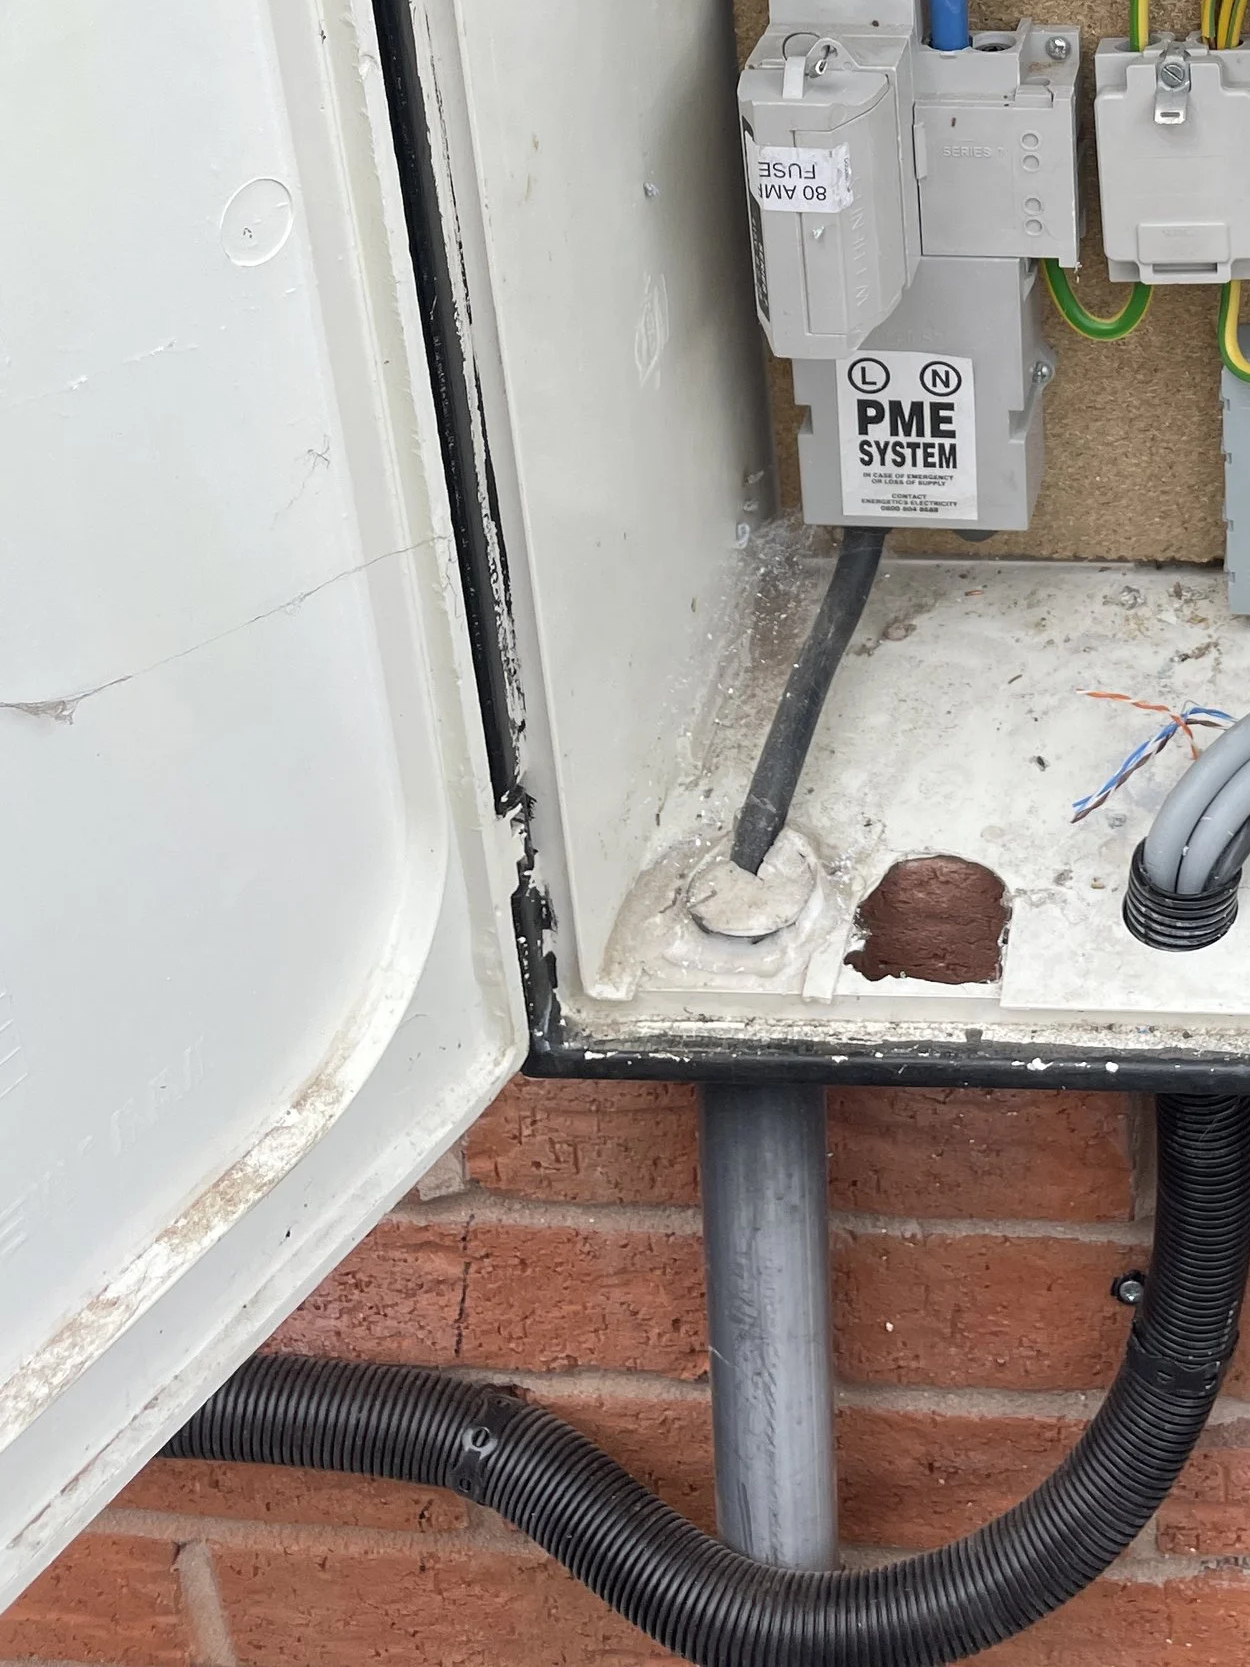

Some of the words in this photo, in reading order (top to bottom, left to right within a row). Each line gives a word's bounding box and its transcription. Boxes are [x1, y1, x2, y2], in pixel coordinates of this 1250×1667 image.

[942, 144, 993, 159] SERIES
[757, 161, 816, 180] FUSE
[802, 185, 827, 201] 80
[856, 398, 957, 439] PME
[858, 439, 958, 470] SYSTEM
[907, 473, 954, 481] EMERGENCY
